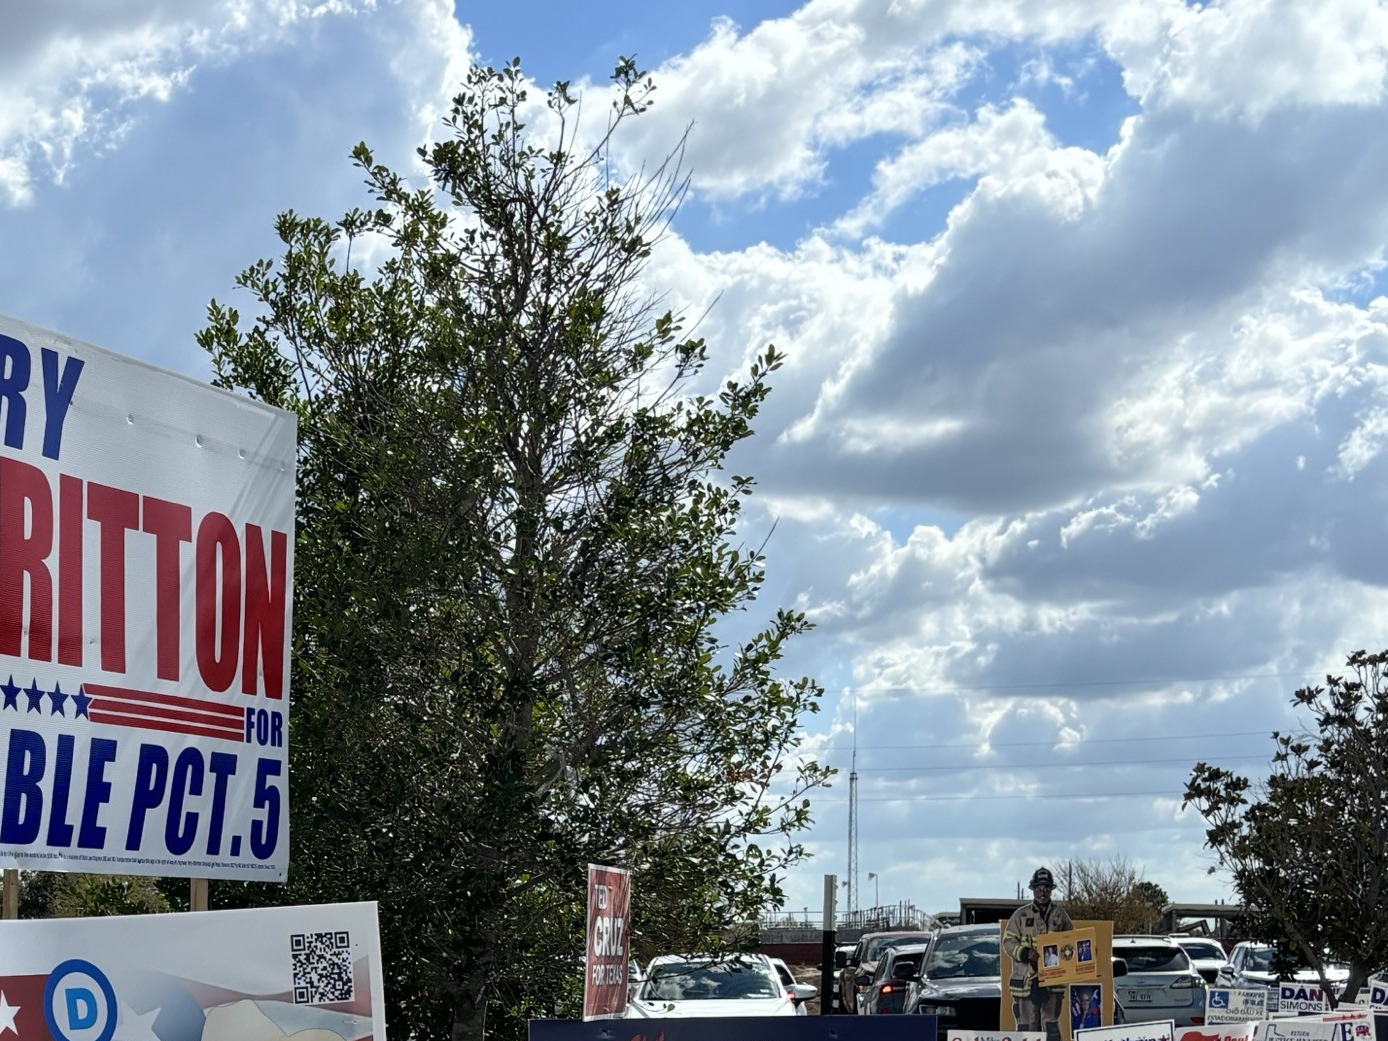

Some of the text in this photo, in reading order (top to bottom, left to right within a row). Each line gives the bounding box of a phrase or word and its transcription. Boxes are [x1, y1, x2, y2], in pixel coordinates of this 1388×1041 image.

[245, 708, 284, 748] FOR
[593, 916, 624, 957] CRUZ
[592, 964, 623, 986] FOR TEXAS
[66, 988, 95, 1031] D
[1280, 1001, 1323, 1011] SIMONS
[1281, 986, 1324, 1002] DAN
